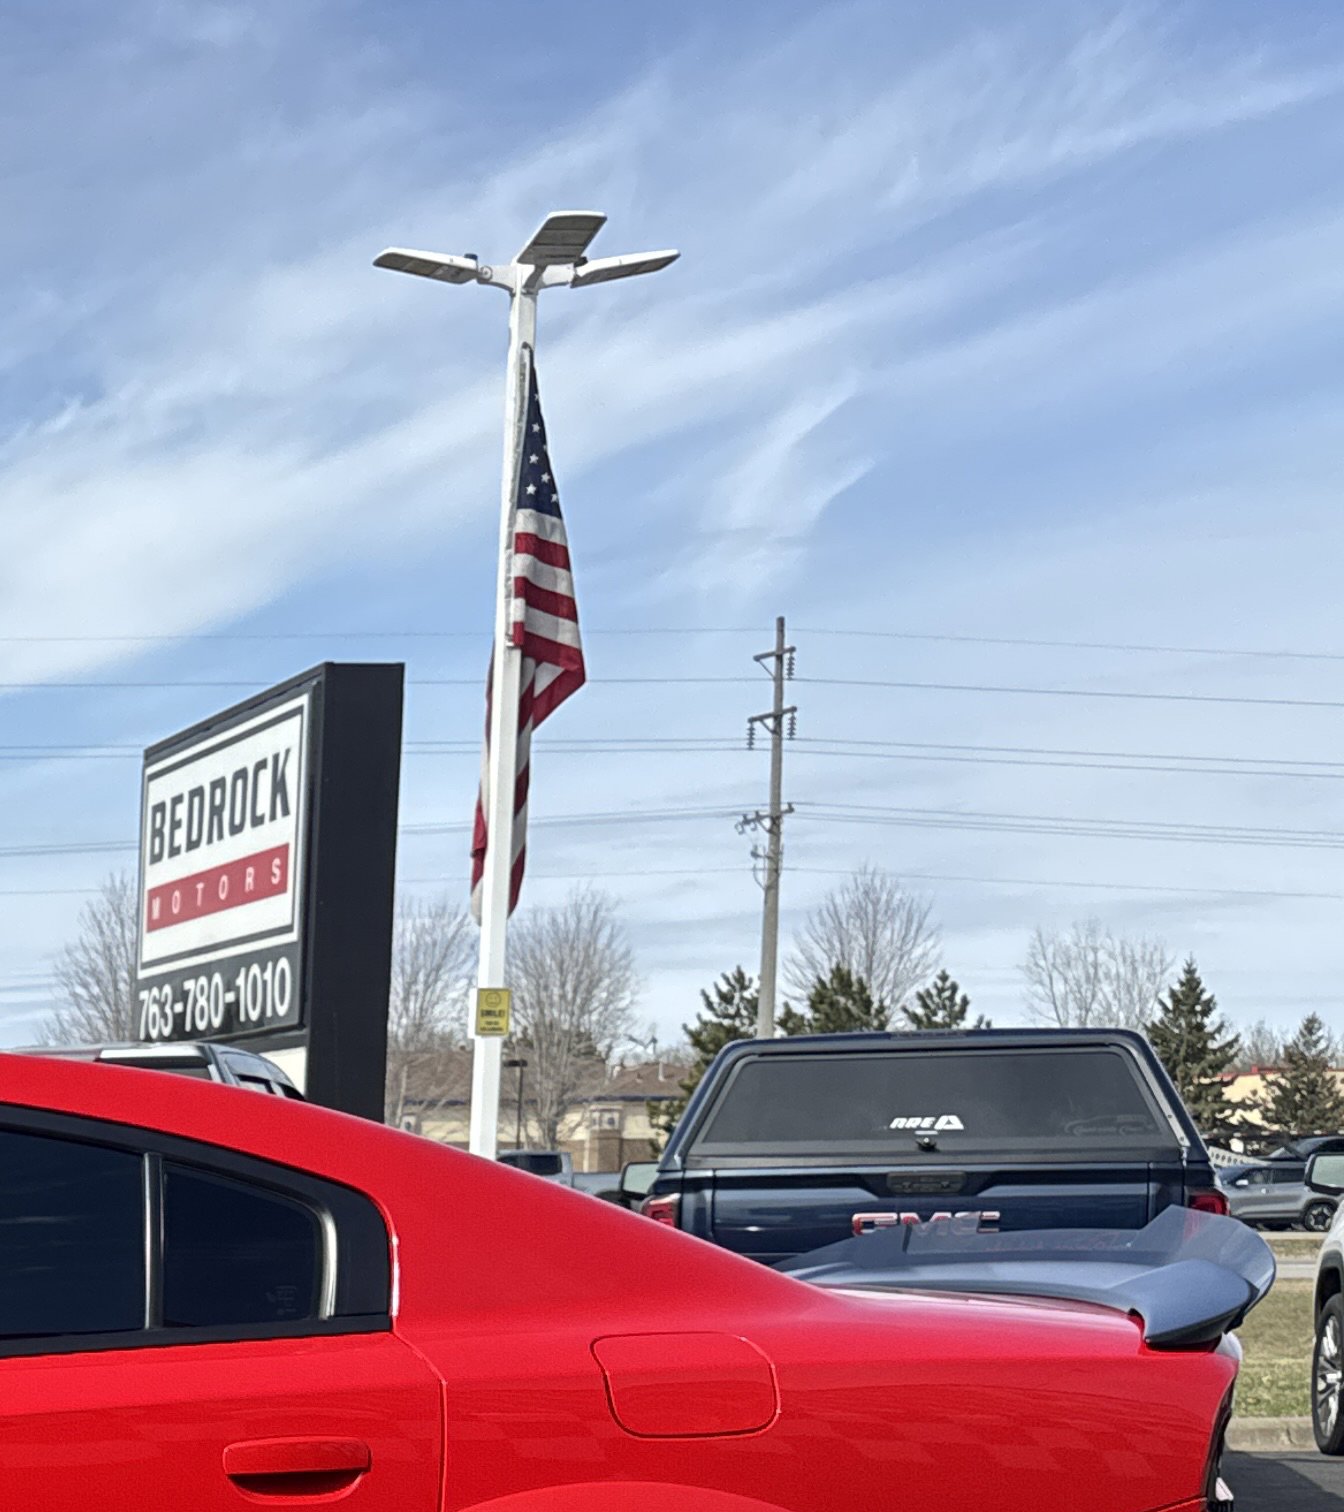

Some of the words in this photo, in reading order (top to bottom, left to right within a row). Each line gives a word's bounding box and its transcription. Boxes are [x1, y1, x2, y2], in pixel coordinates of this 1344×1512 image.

[149, 747, 291, 865] BEDROCK
[152, 857, 282, 920] MOTORS
[139, 956, 292, 1041] 763-780-1010
